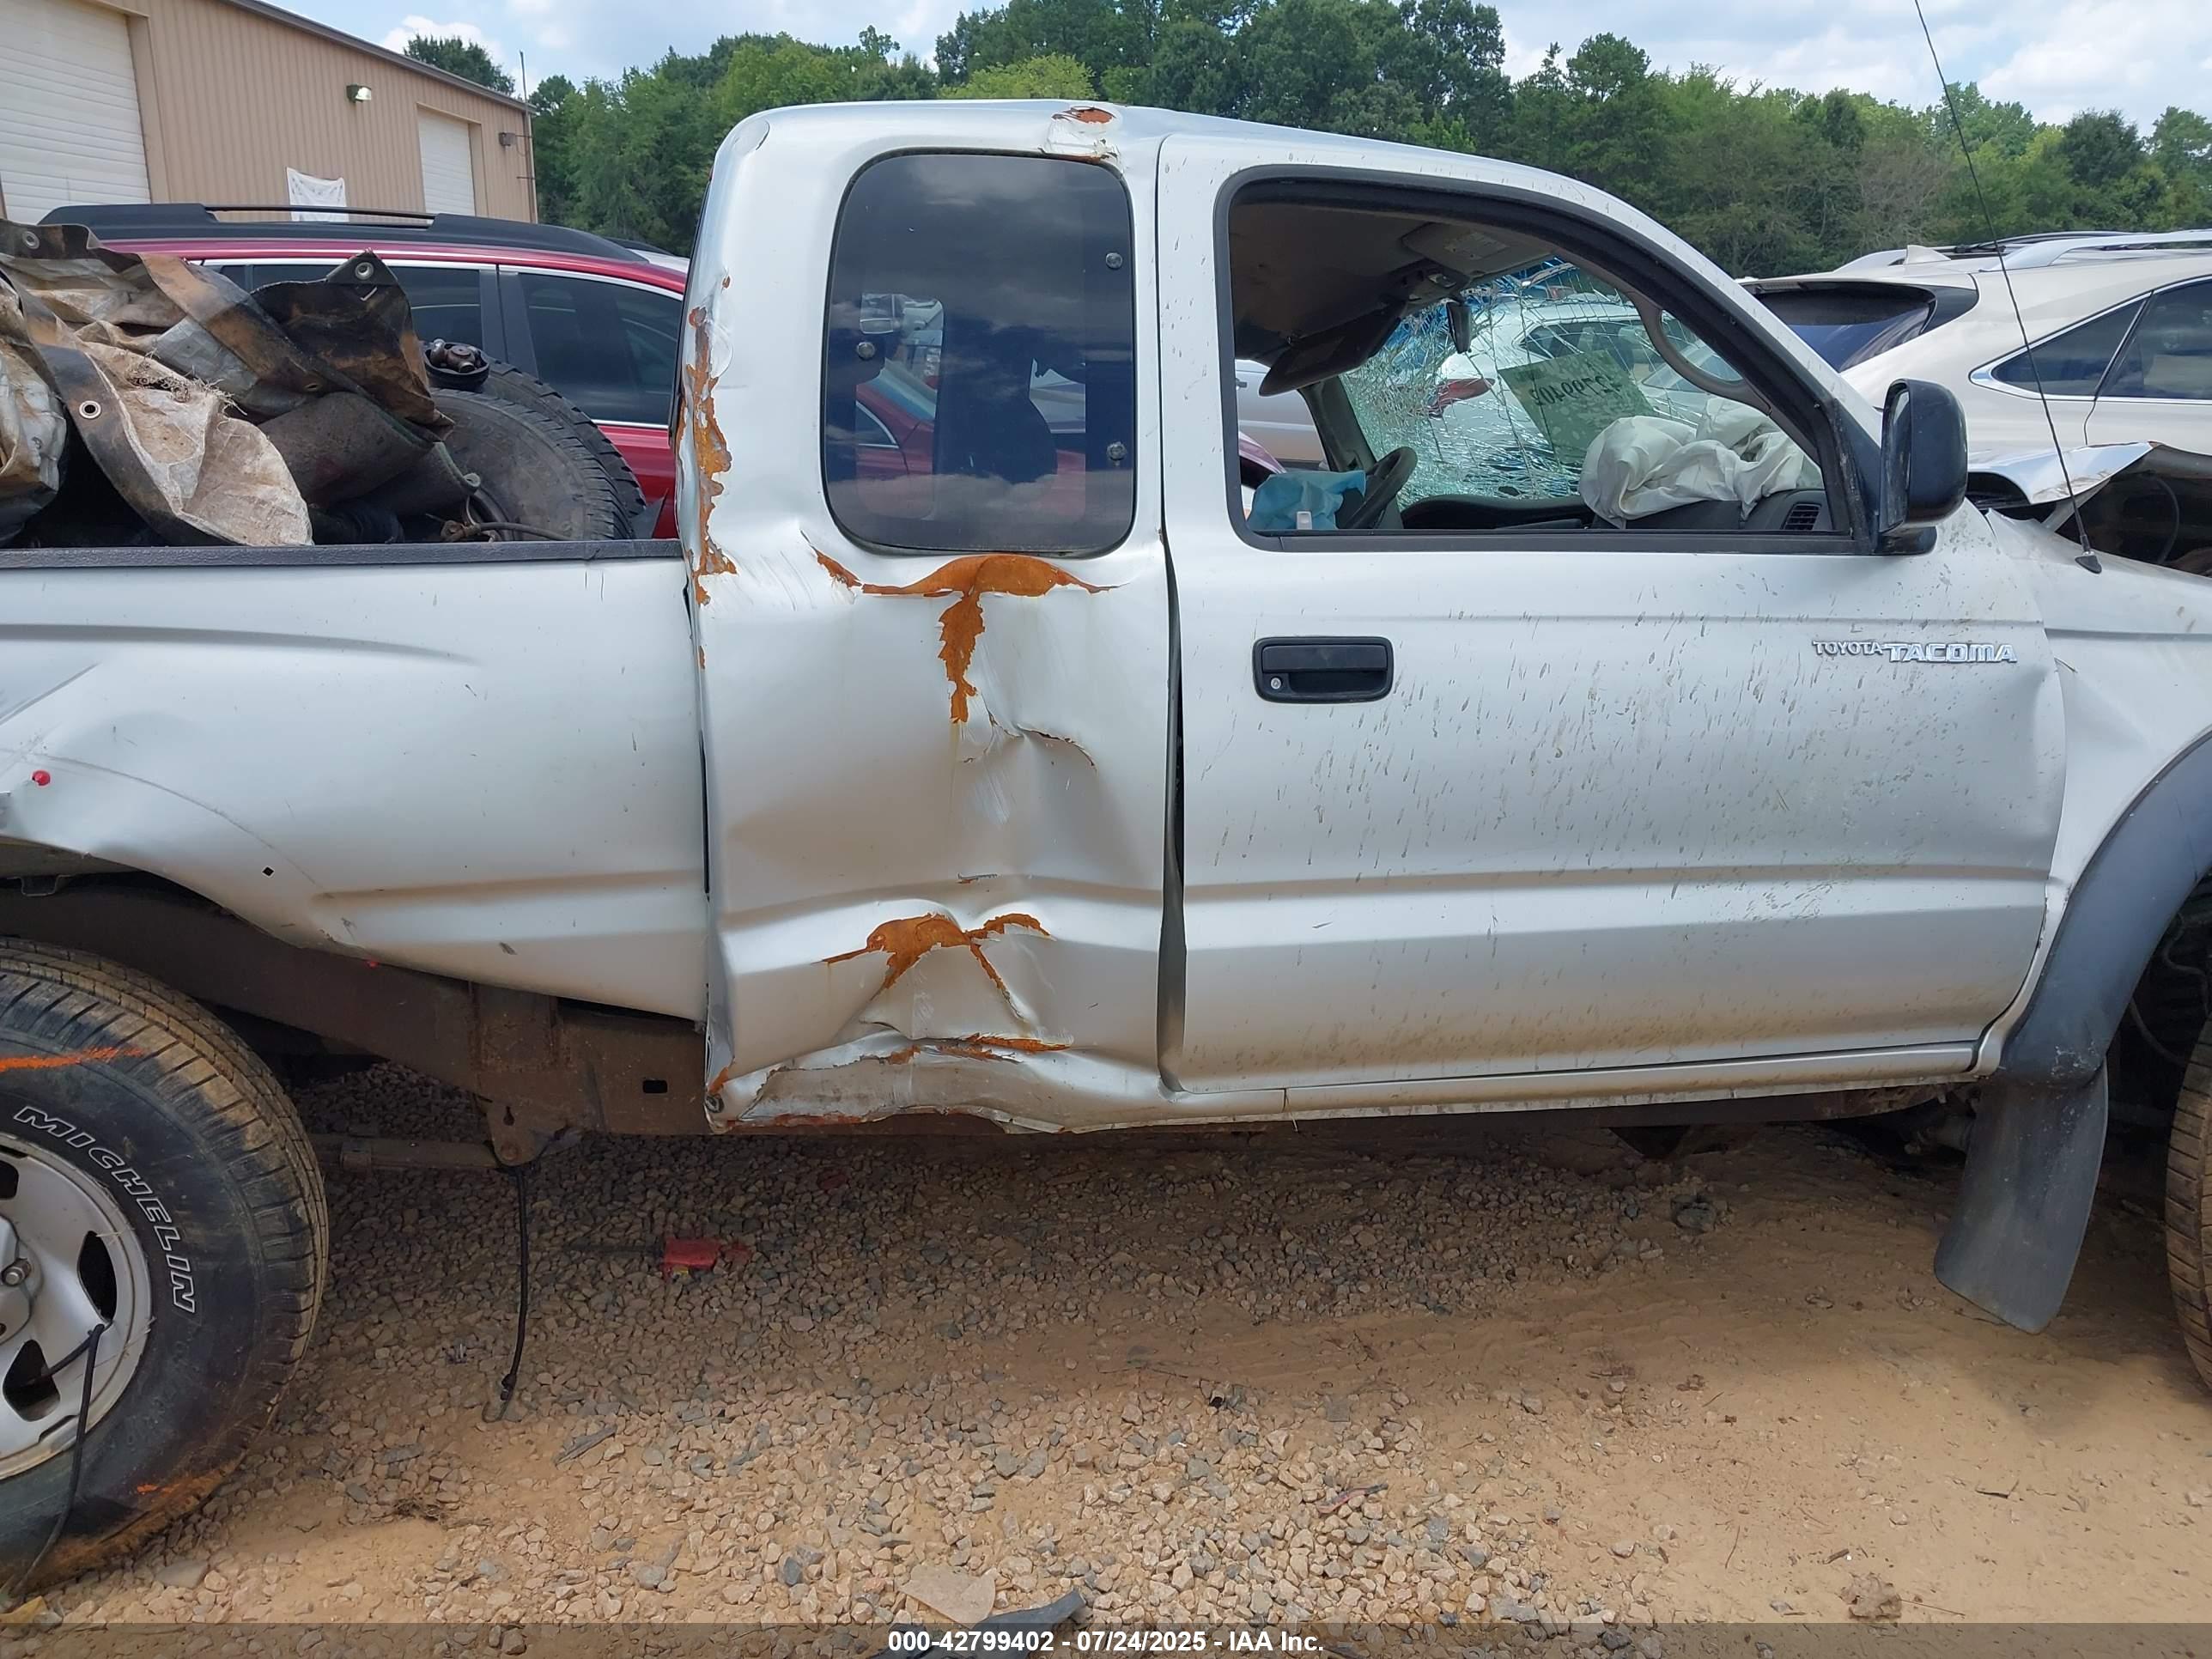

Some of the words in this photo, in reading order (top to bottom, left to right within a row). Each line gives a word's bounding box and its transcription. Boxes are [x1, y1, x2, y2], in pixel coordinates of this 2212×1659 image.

[1813, 641, 1883, 656] TOYOTA
[1882, 642, 2018, 663] TACOMA
[14, 1106, 197, 1314] MICHELIN
